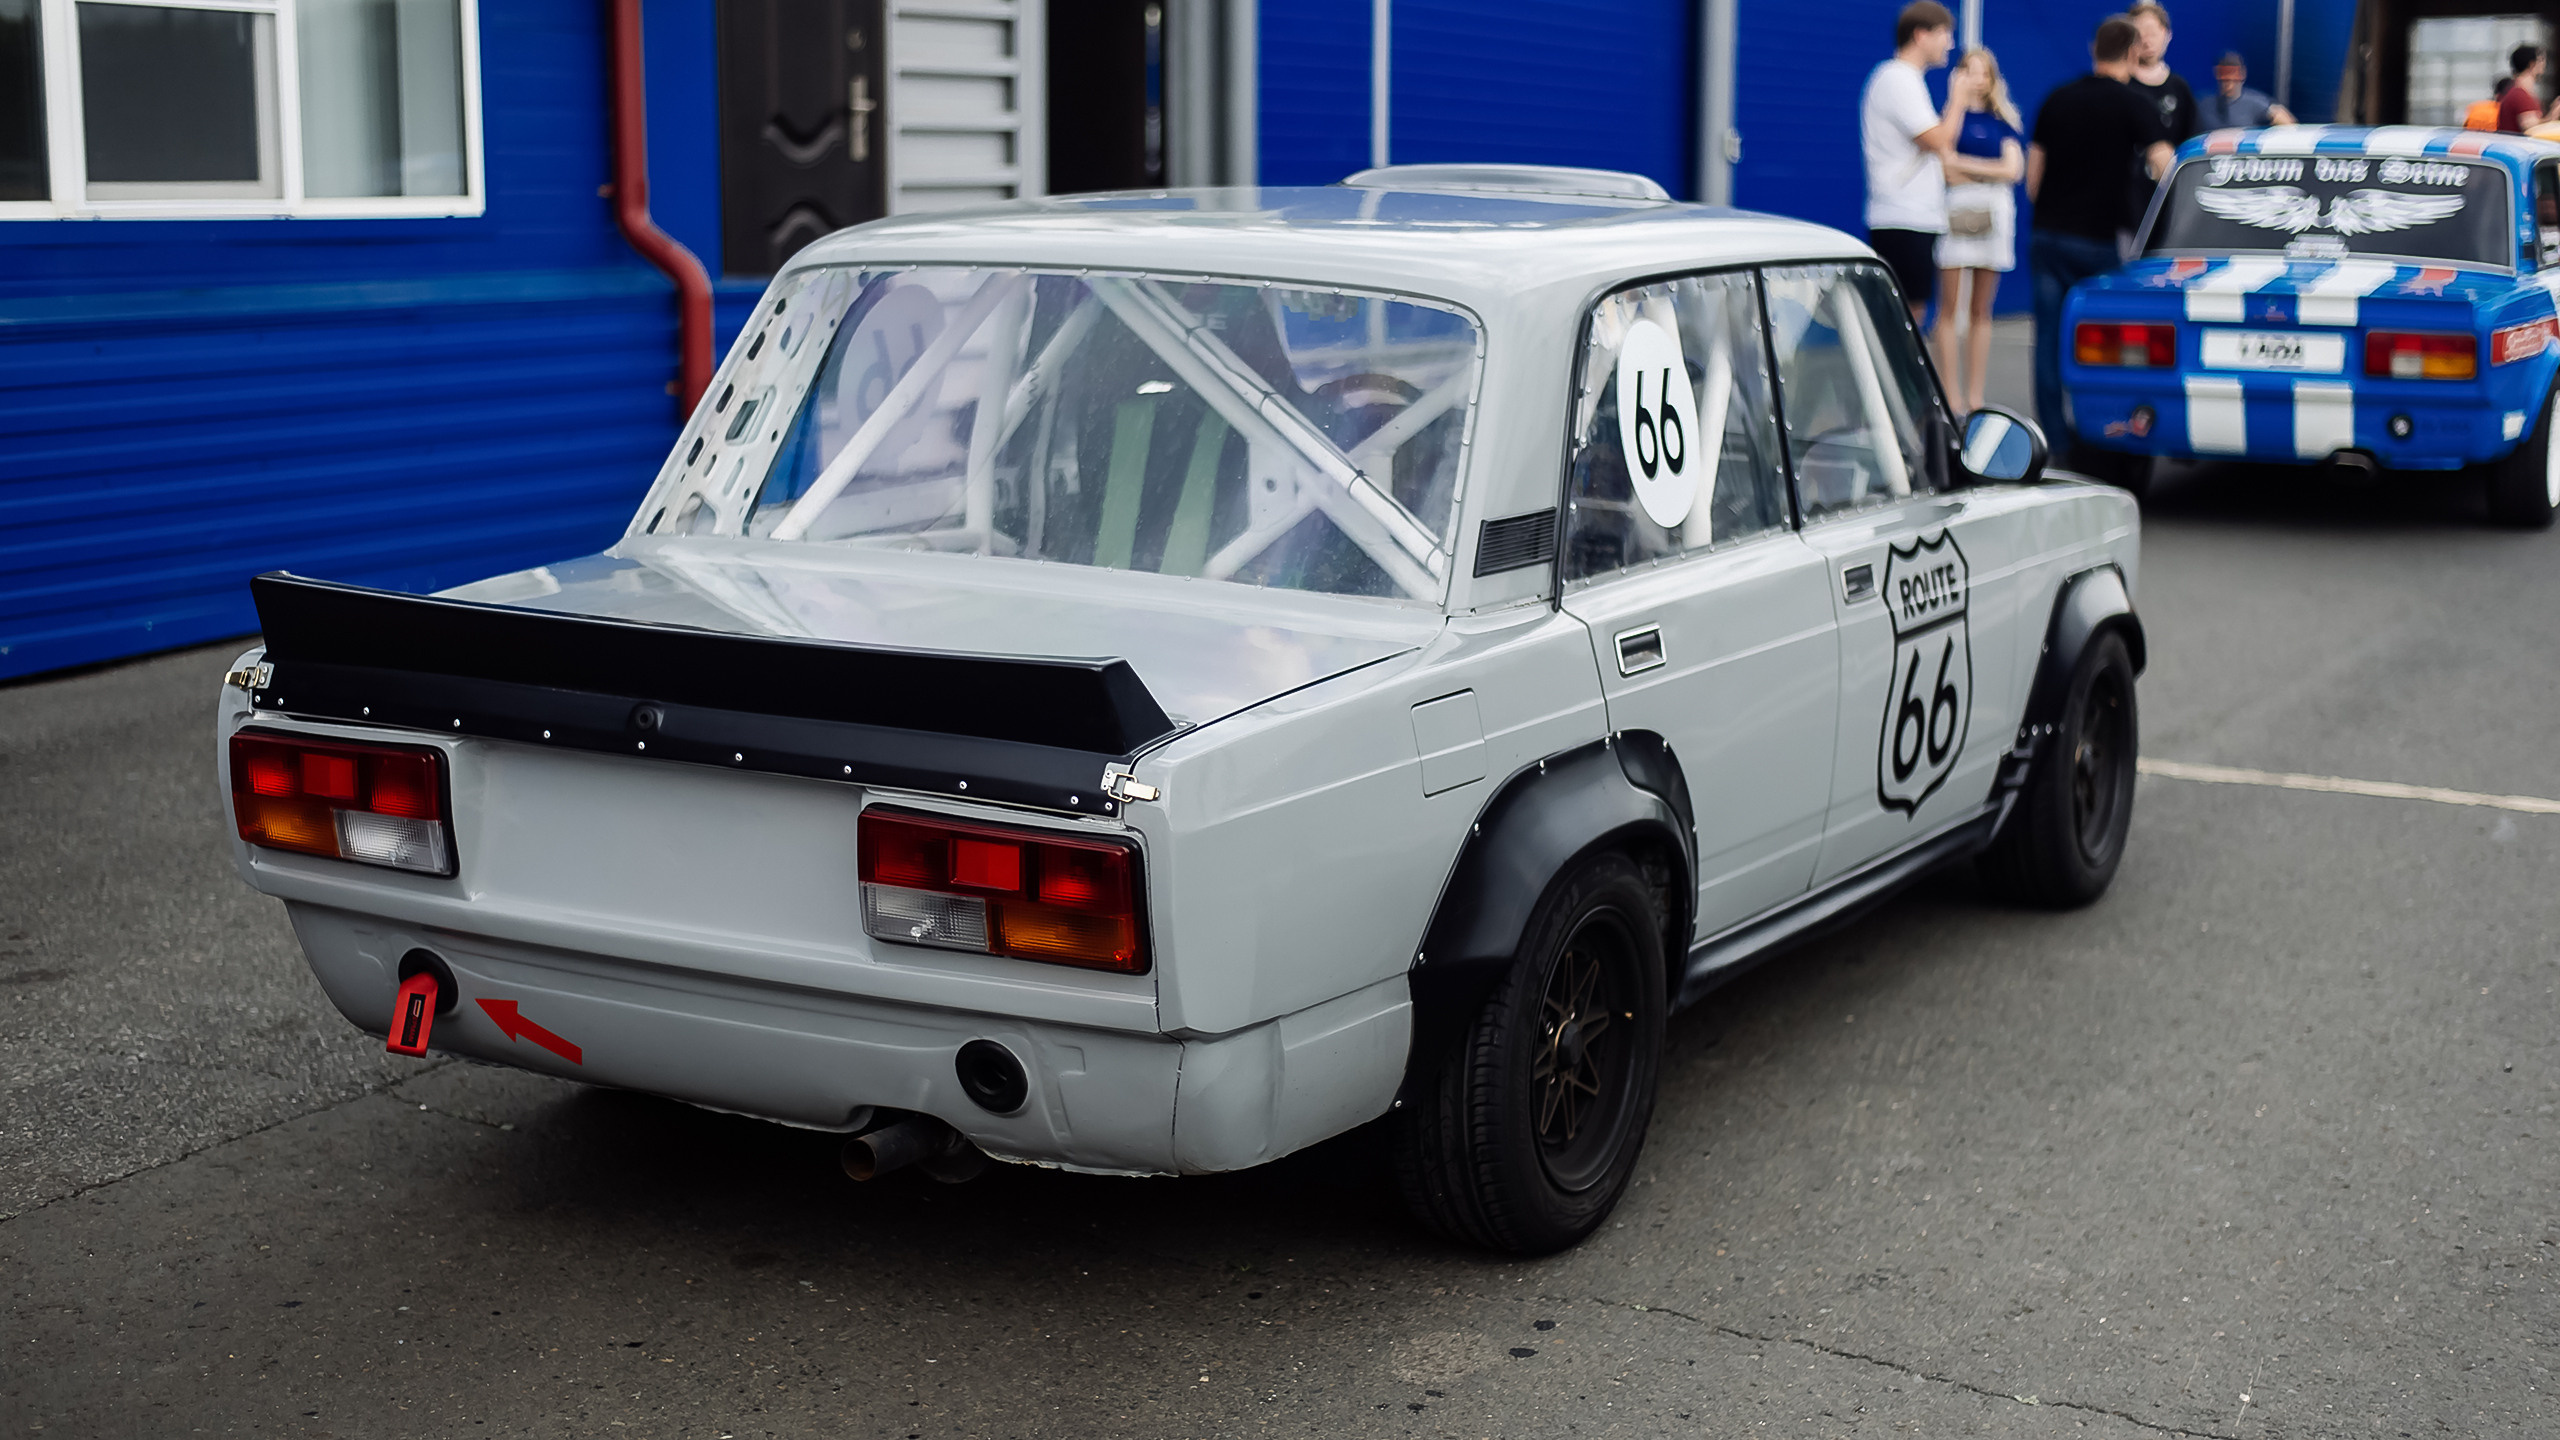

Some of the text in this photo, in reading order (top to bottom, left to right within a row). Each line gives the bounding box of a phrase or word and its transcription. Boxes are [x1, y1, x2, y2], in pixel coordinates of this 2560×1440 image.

[1635, 368, 1684, 480] 66
[1900, 563, 1959, 619] ROUTE
[1893, 636, 1958, 784] 66
